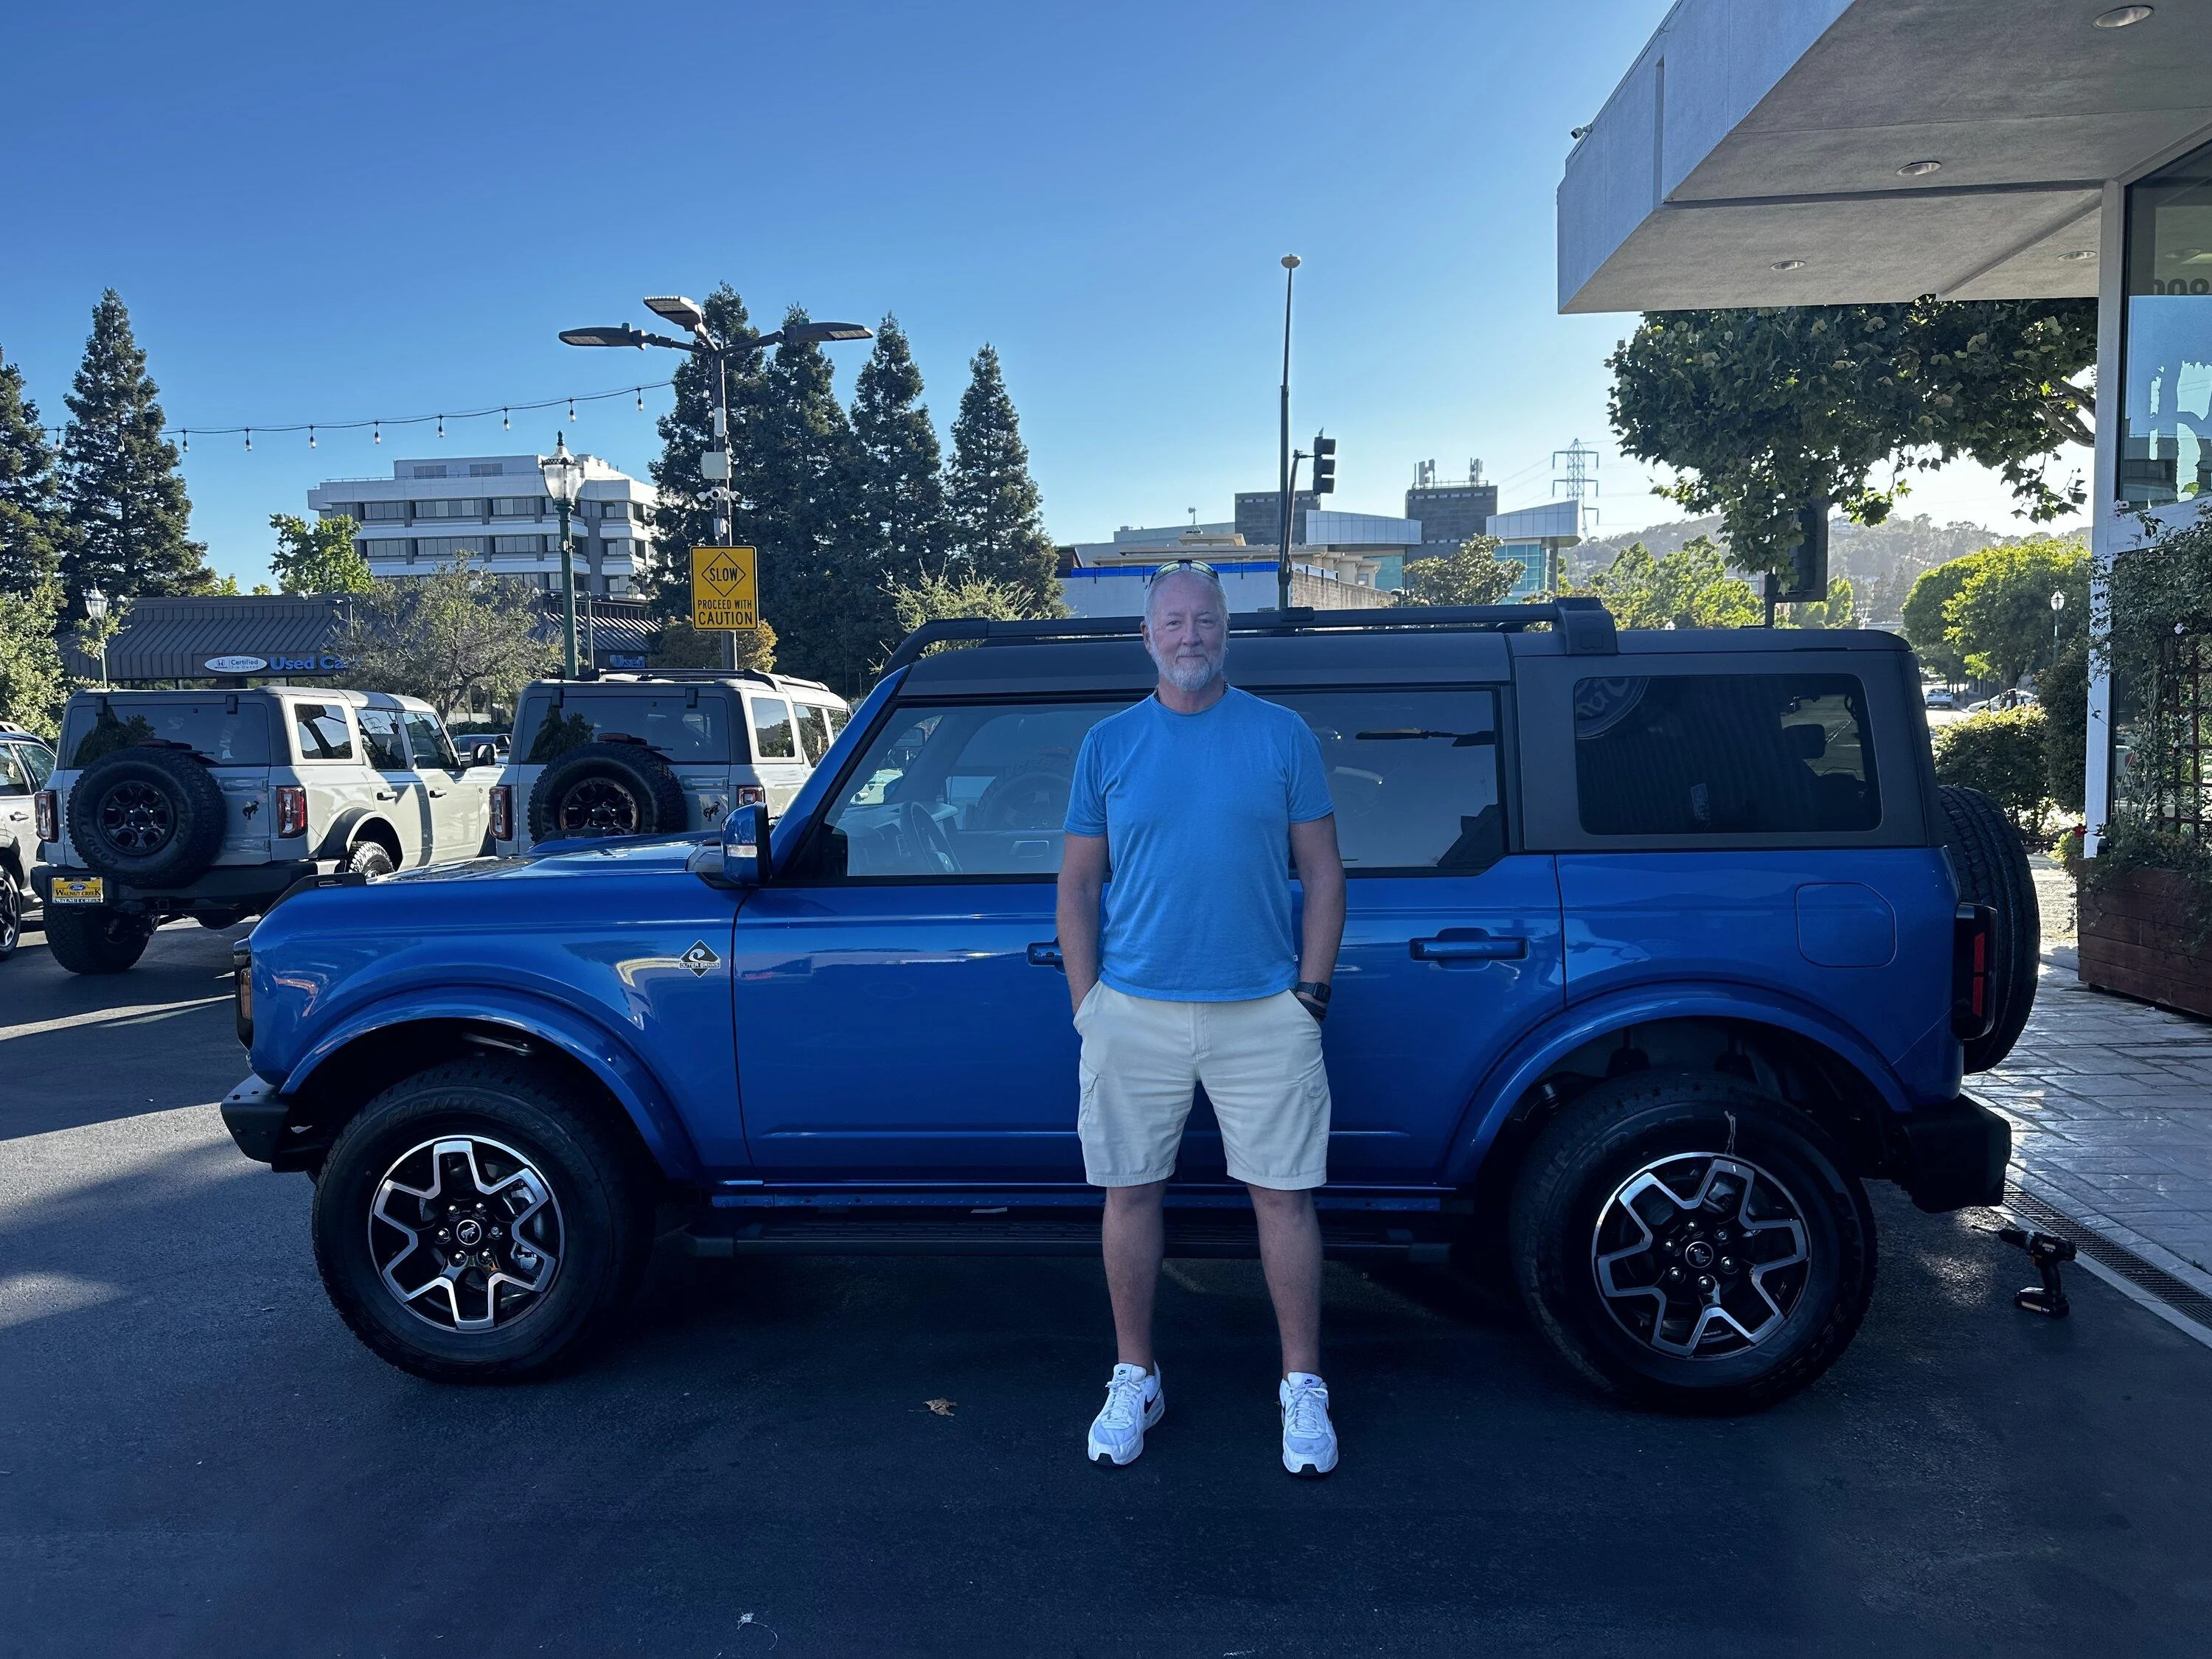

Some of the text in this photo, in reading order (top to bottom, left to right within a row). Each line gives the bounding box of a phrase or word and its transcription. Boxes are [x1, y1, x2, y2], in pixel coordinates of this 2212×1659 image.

[709, 568, 737, 582] SLOW
[698, 599, 752, 610] PROCEED WITH
[698, 611, 753, 625] CAUTION
[270, 656, 316, 670] Used
[81, 888, 101, 896] CREEK
